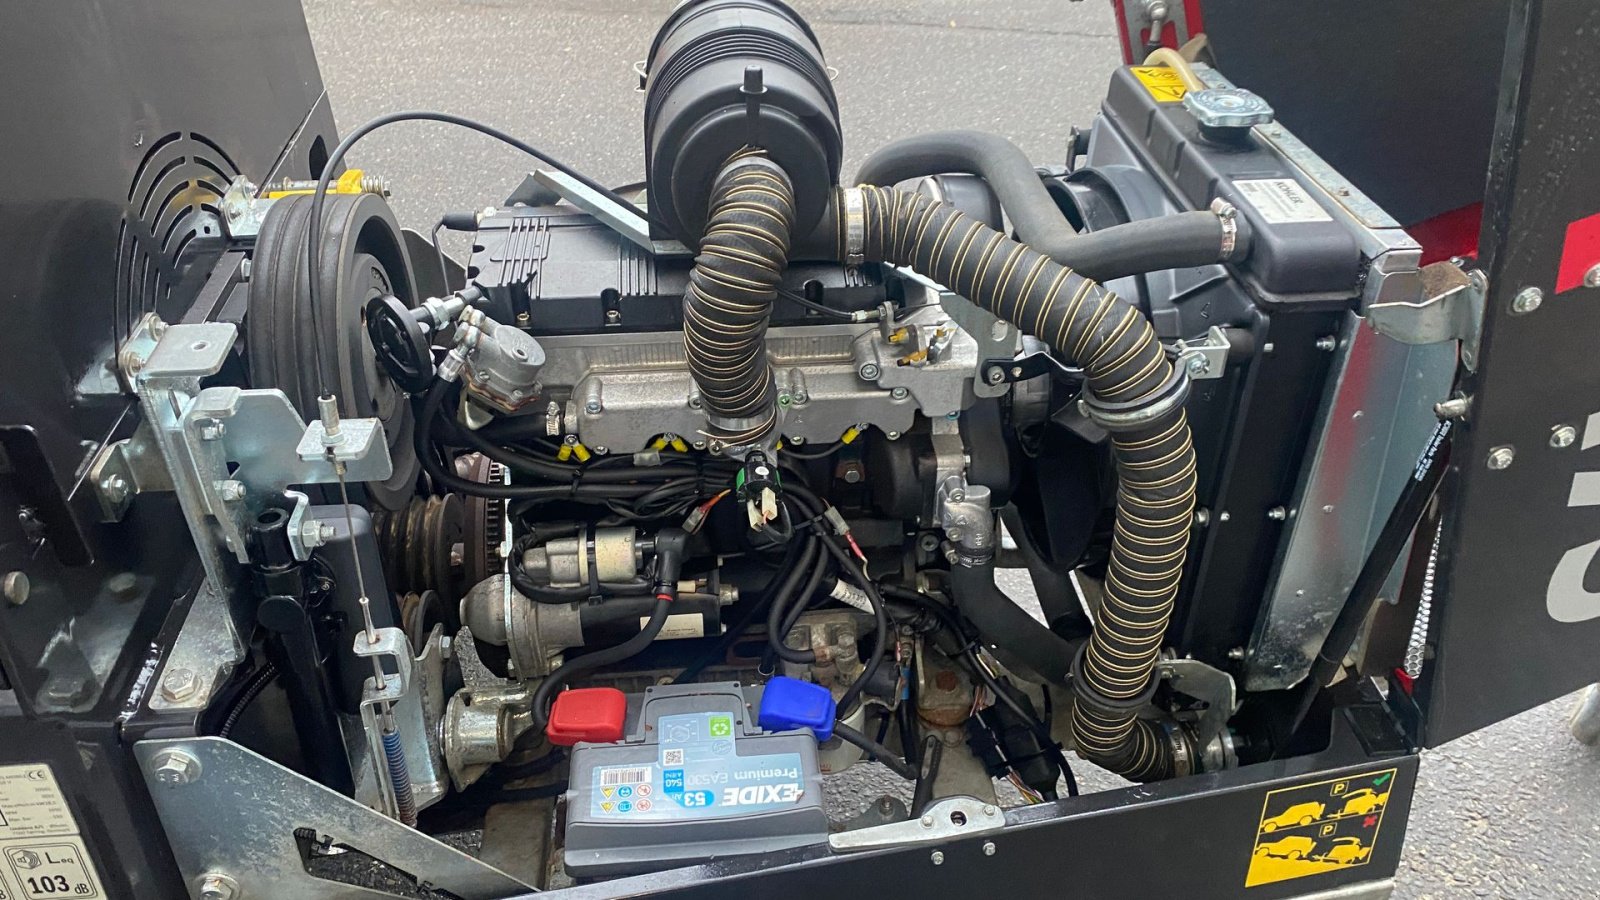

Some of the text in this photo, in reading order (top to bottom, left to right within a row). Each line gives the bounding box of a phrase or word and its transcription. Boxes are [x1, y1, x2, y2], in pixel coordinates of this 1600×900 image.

[1275, 181, 1304, 204] KOHLER
[665, 778, 682, 787] 540
[687, 768, 798, 785] Premium EA530
[721, 783, 804, 806] EXIDE
[1333, 783, 1345, 794] P
[684, 792, 706, 806] 53
[1322, 825, 1334, 836] P
[27, 875, 90, 895] 103 dB
